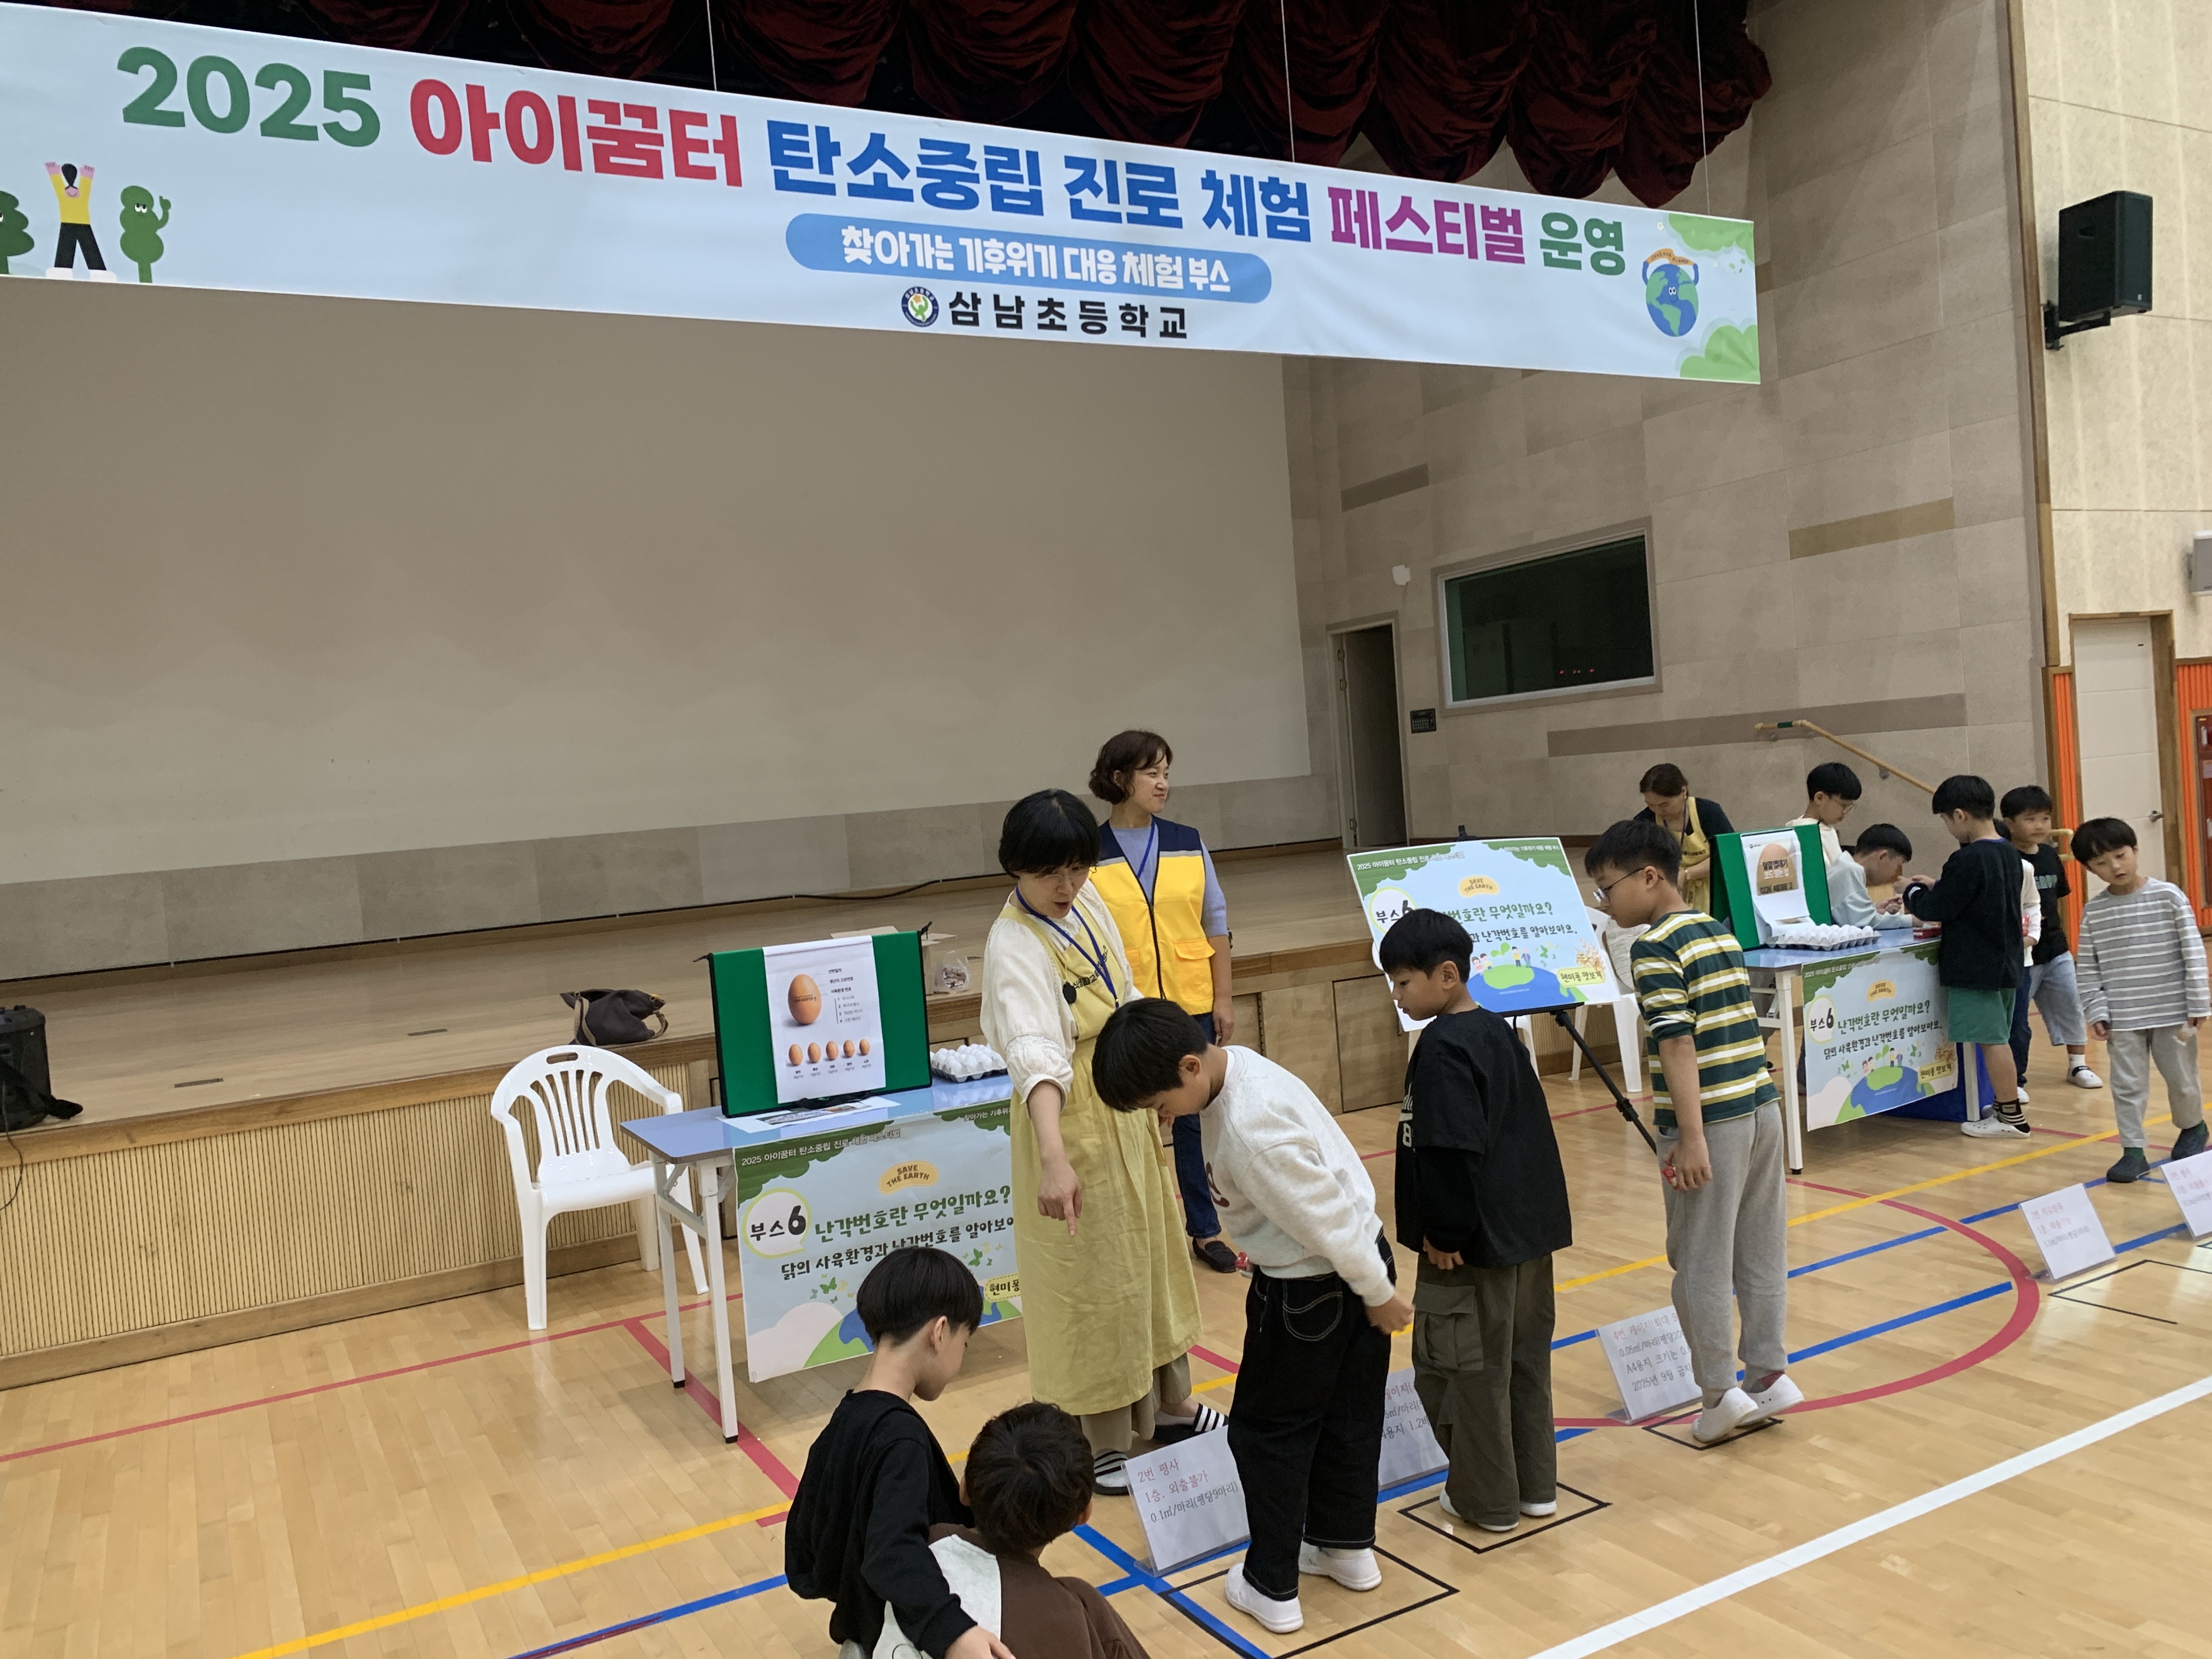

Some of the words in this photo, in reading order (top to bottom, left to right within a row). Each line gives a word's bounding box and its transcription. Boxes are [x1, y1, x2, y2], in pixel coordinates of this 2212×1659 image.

[116, 46, 381, 147] 2025
[410, 78, 743, 188] 아이꿈터
[767, 119, 1043, 217] 탄소중립
[1064, 155, 1183, 228] 진로
[1200, 170, 1311, 242] 체험
[1327, 185, 1526, 265] 페스티벌
[1539, 211, 1626, 276] 운영
[841, 226, 954, 272] 찾아가는
[958, 238, 1057, 280] 기후위기
[1064, 247, 1117, 285] 대응
[1123, 252, 1183, 289] 체험
[1188, 259, 1231, 294] 부스
[949, 290, 1188, 339] 삼남초등학교
[1373, 860, 1395, 868] 아이꿈터
[1489, 902, 1552, 919] 무엇일까요?
[1482, 928, 1528, 943] 난각번호를
[1531, 924, 1577, 935] 알아보아요.
[1838, 1011, 1880, 1035] 난각번호란
[1882, 1000, 1930, 1023] 무엇일까요?
[1824, 1046, 1837, 1060] 닭의
[1838, 1037, 1871, 1054] 사육환경과
[1872, 1027, 1905, 1046] 난각번호를
[1907, 1020, 1942, 1037] 알아보아요.
[990, 1107, 1011, 1116] 기후위
[742, 1156, 761, 1166] 2025
[764, 1149, 796, 1161] 아이꿈터
[799, 1142, 831, 1155] 탄소중립
[834, 1138, 850, 1149] 진로
[887, 1176, 902, 1187] THE
[904, 1172, 929, 1181] EARTH
[897, 1165, 918, 1175] SAVE
[815, 1206, 908, 1243] 난각번호란
[913, 1185, 1011, 1221] 무엇일까요?
[781, 1260, 810, 1280] 닭의
[815, 1243, 887, 1269] 사육환경과
[1627, 1357, 1652, 1374] A4용지
[1656, 1350, 1678, 1364] 크기는
[1632, 1374, 1659, 1391] 2025년
[1661, 1369, 1674, 1381] 9월
[1138, 1467, 1155, 1483] 2번
[1159, 1458, 1179, 1476] 평사
[1145, 1489, 1165, 1503] 1층,
[1169, 1470, 1208, 1493] 외출불가
